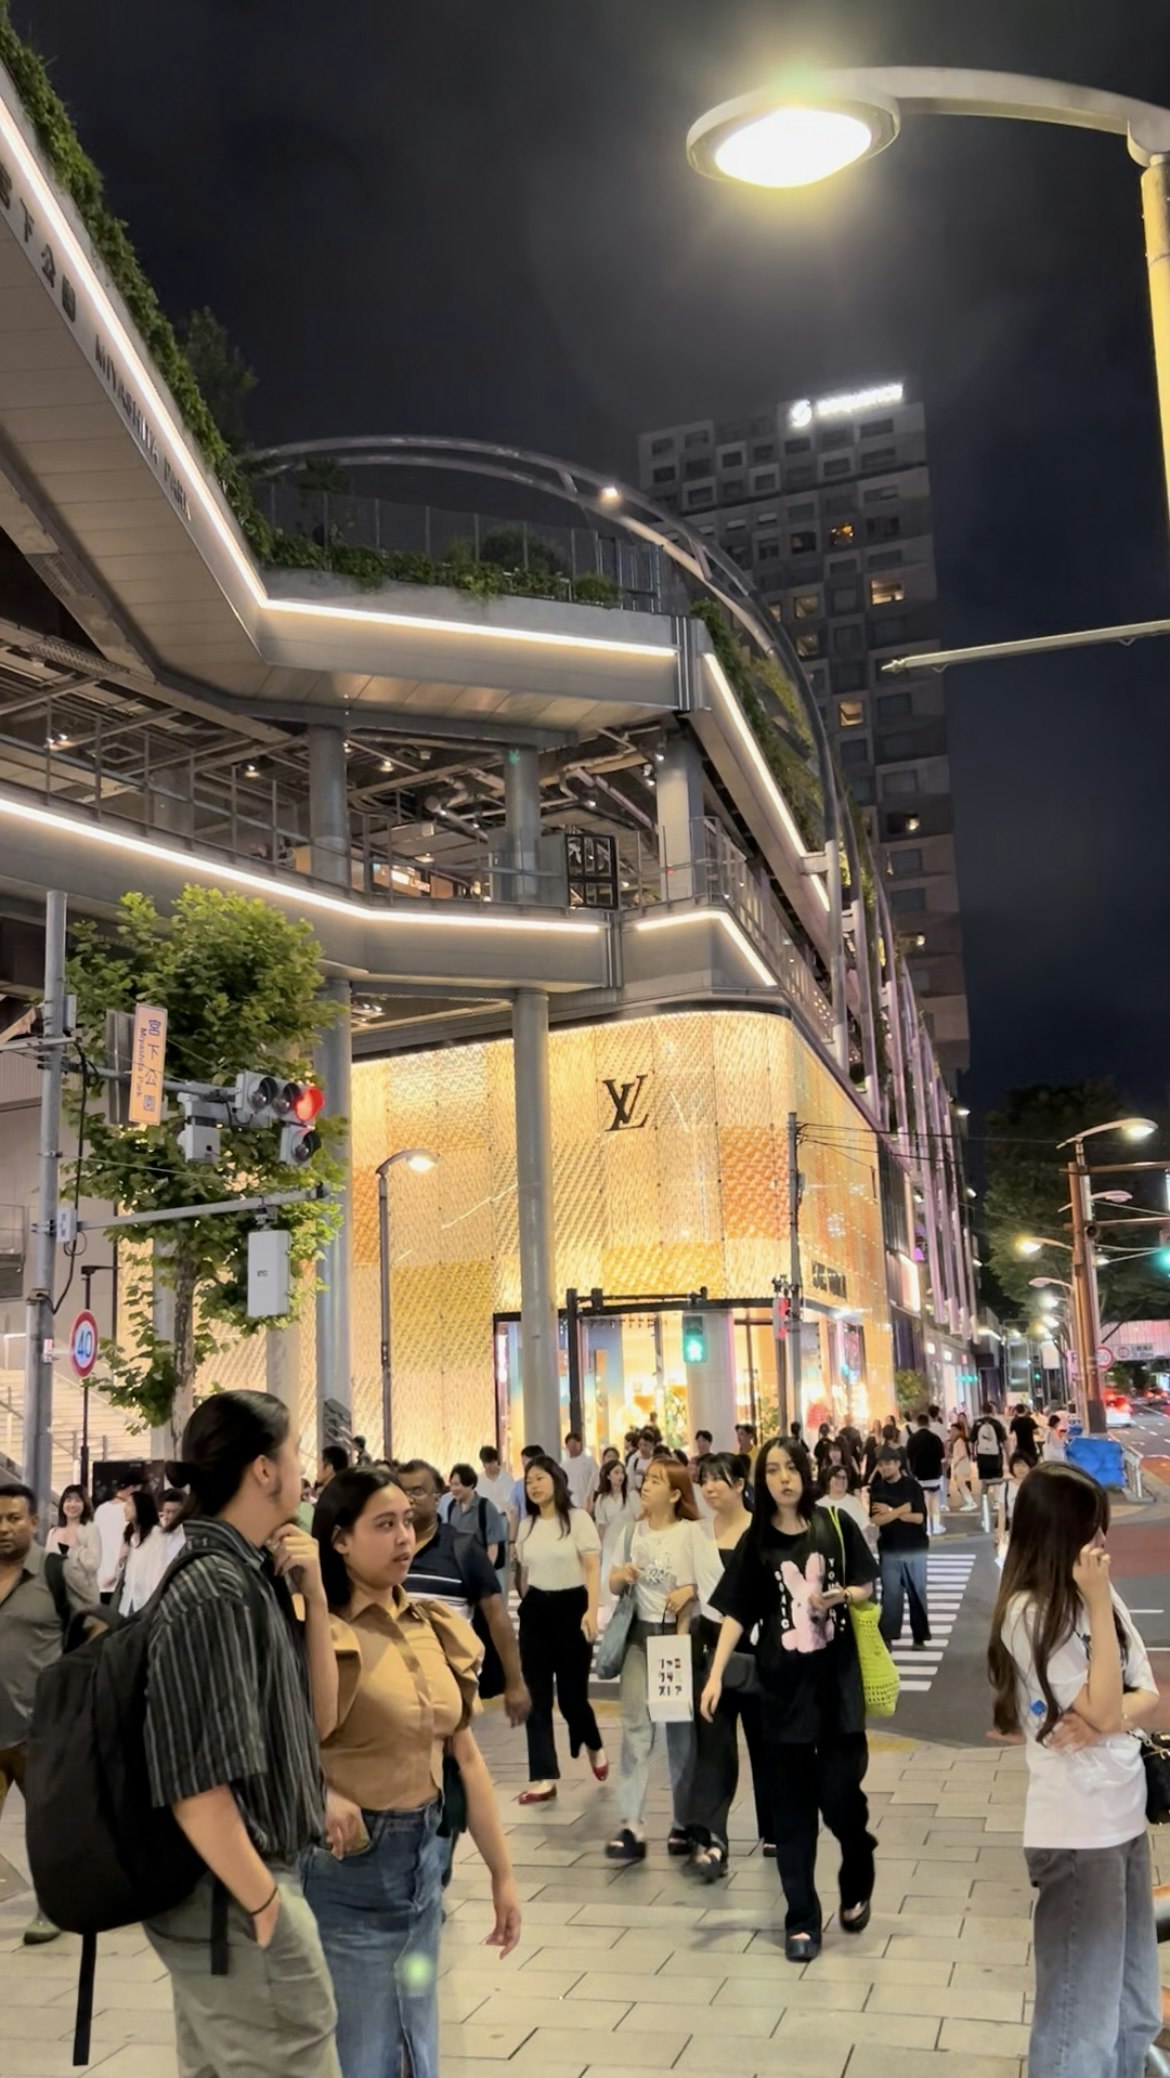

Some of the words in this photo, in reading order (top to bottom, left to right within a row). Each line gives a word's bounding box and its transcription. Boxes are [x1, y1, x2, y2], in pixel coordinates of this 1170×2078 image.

[95, 333, 159, 465] MIYASHITA
[138, 1027, 147, 1072] Miyashita
[143, 1019, 161, 1113] 宮下公園
[136, 1076, 144, 1097] Park
[602, 1075, 649, 1132] LV
[76, 1330, 93, 1359] 40
